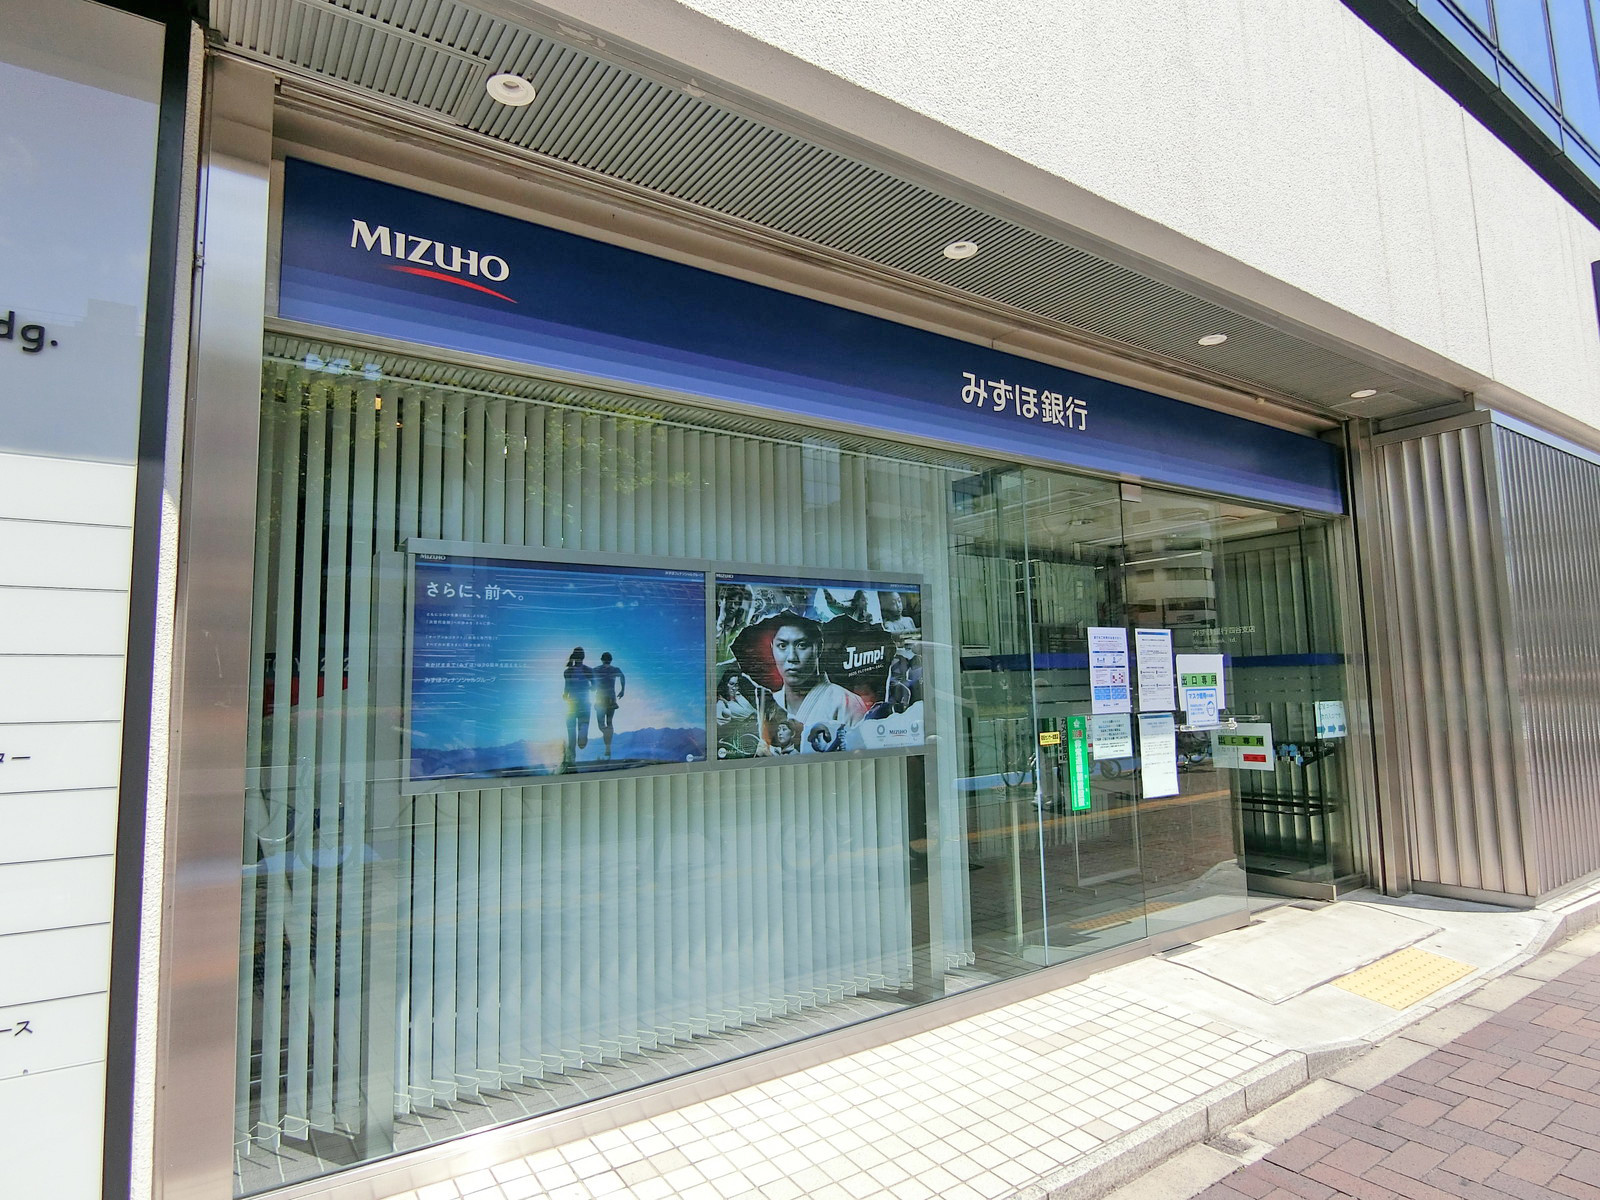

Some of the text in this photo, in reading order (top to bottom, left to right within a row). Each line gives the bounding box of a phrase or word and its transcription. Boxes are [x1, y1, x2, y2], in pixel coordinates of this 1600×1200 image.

[351, 219, 510, 282] MIZUHO
[961, 371, 1088, 431] みずほ銀行
[426, 581, 524, 601] さらに、前へ。
[843, 646, 884, 670] Jump!
